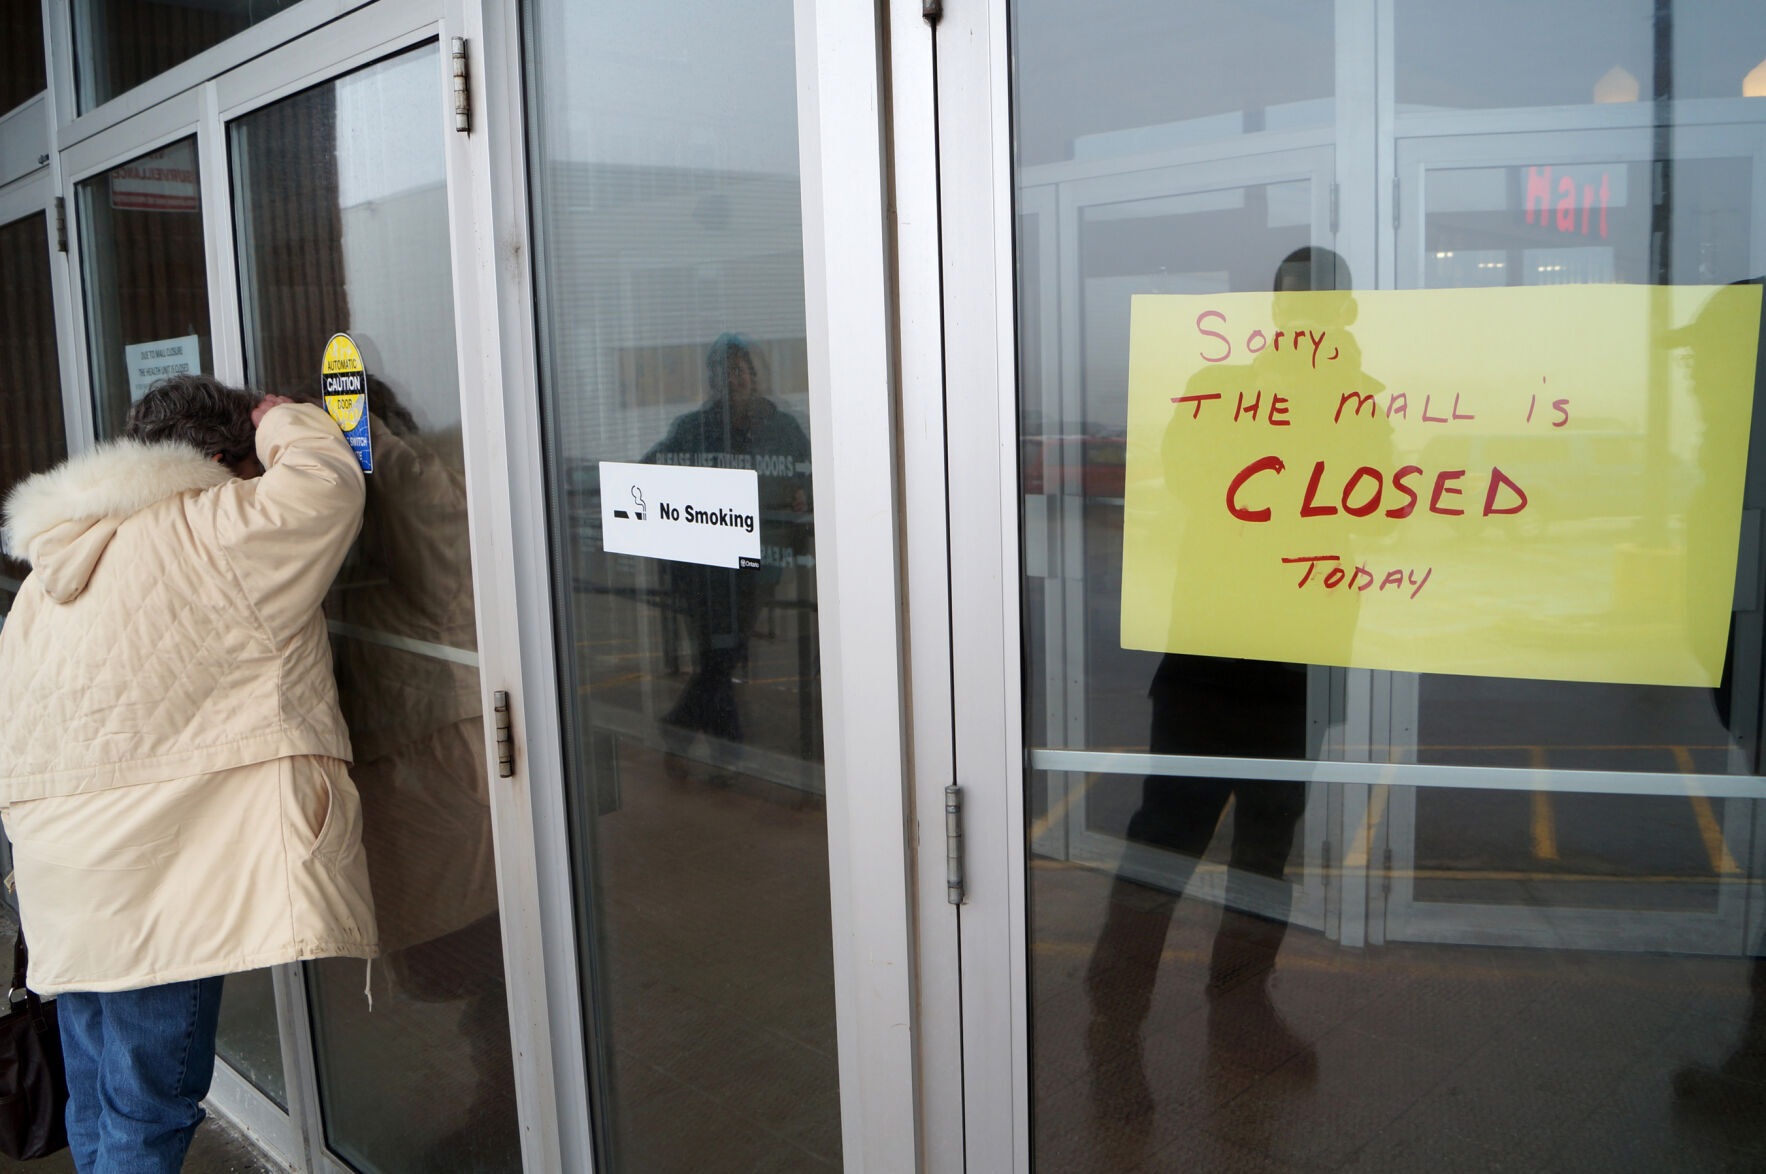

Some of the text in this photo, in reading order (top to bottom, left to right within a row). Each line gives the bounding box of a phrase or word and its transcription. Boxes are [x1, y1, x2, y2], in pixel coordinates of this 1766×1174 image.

[1525, 165, 1609, 239] Hart
[1196, 310, 1339, 368] Sorry,
[327, 359, 357, 371] AUTOMATIC
[326, 376, 361, 391] CAUTION
[337, 399, 353, 410] DOOR
[1171, 390, 1291, 426] THE
[1526, 376, 1570, 427] is
[756, 455, 793, 477] DOORS
[1226, 455, 1528, 522] CLOSED
[659, 502, 754, 533] No Smoking
